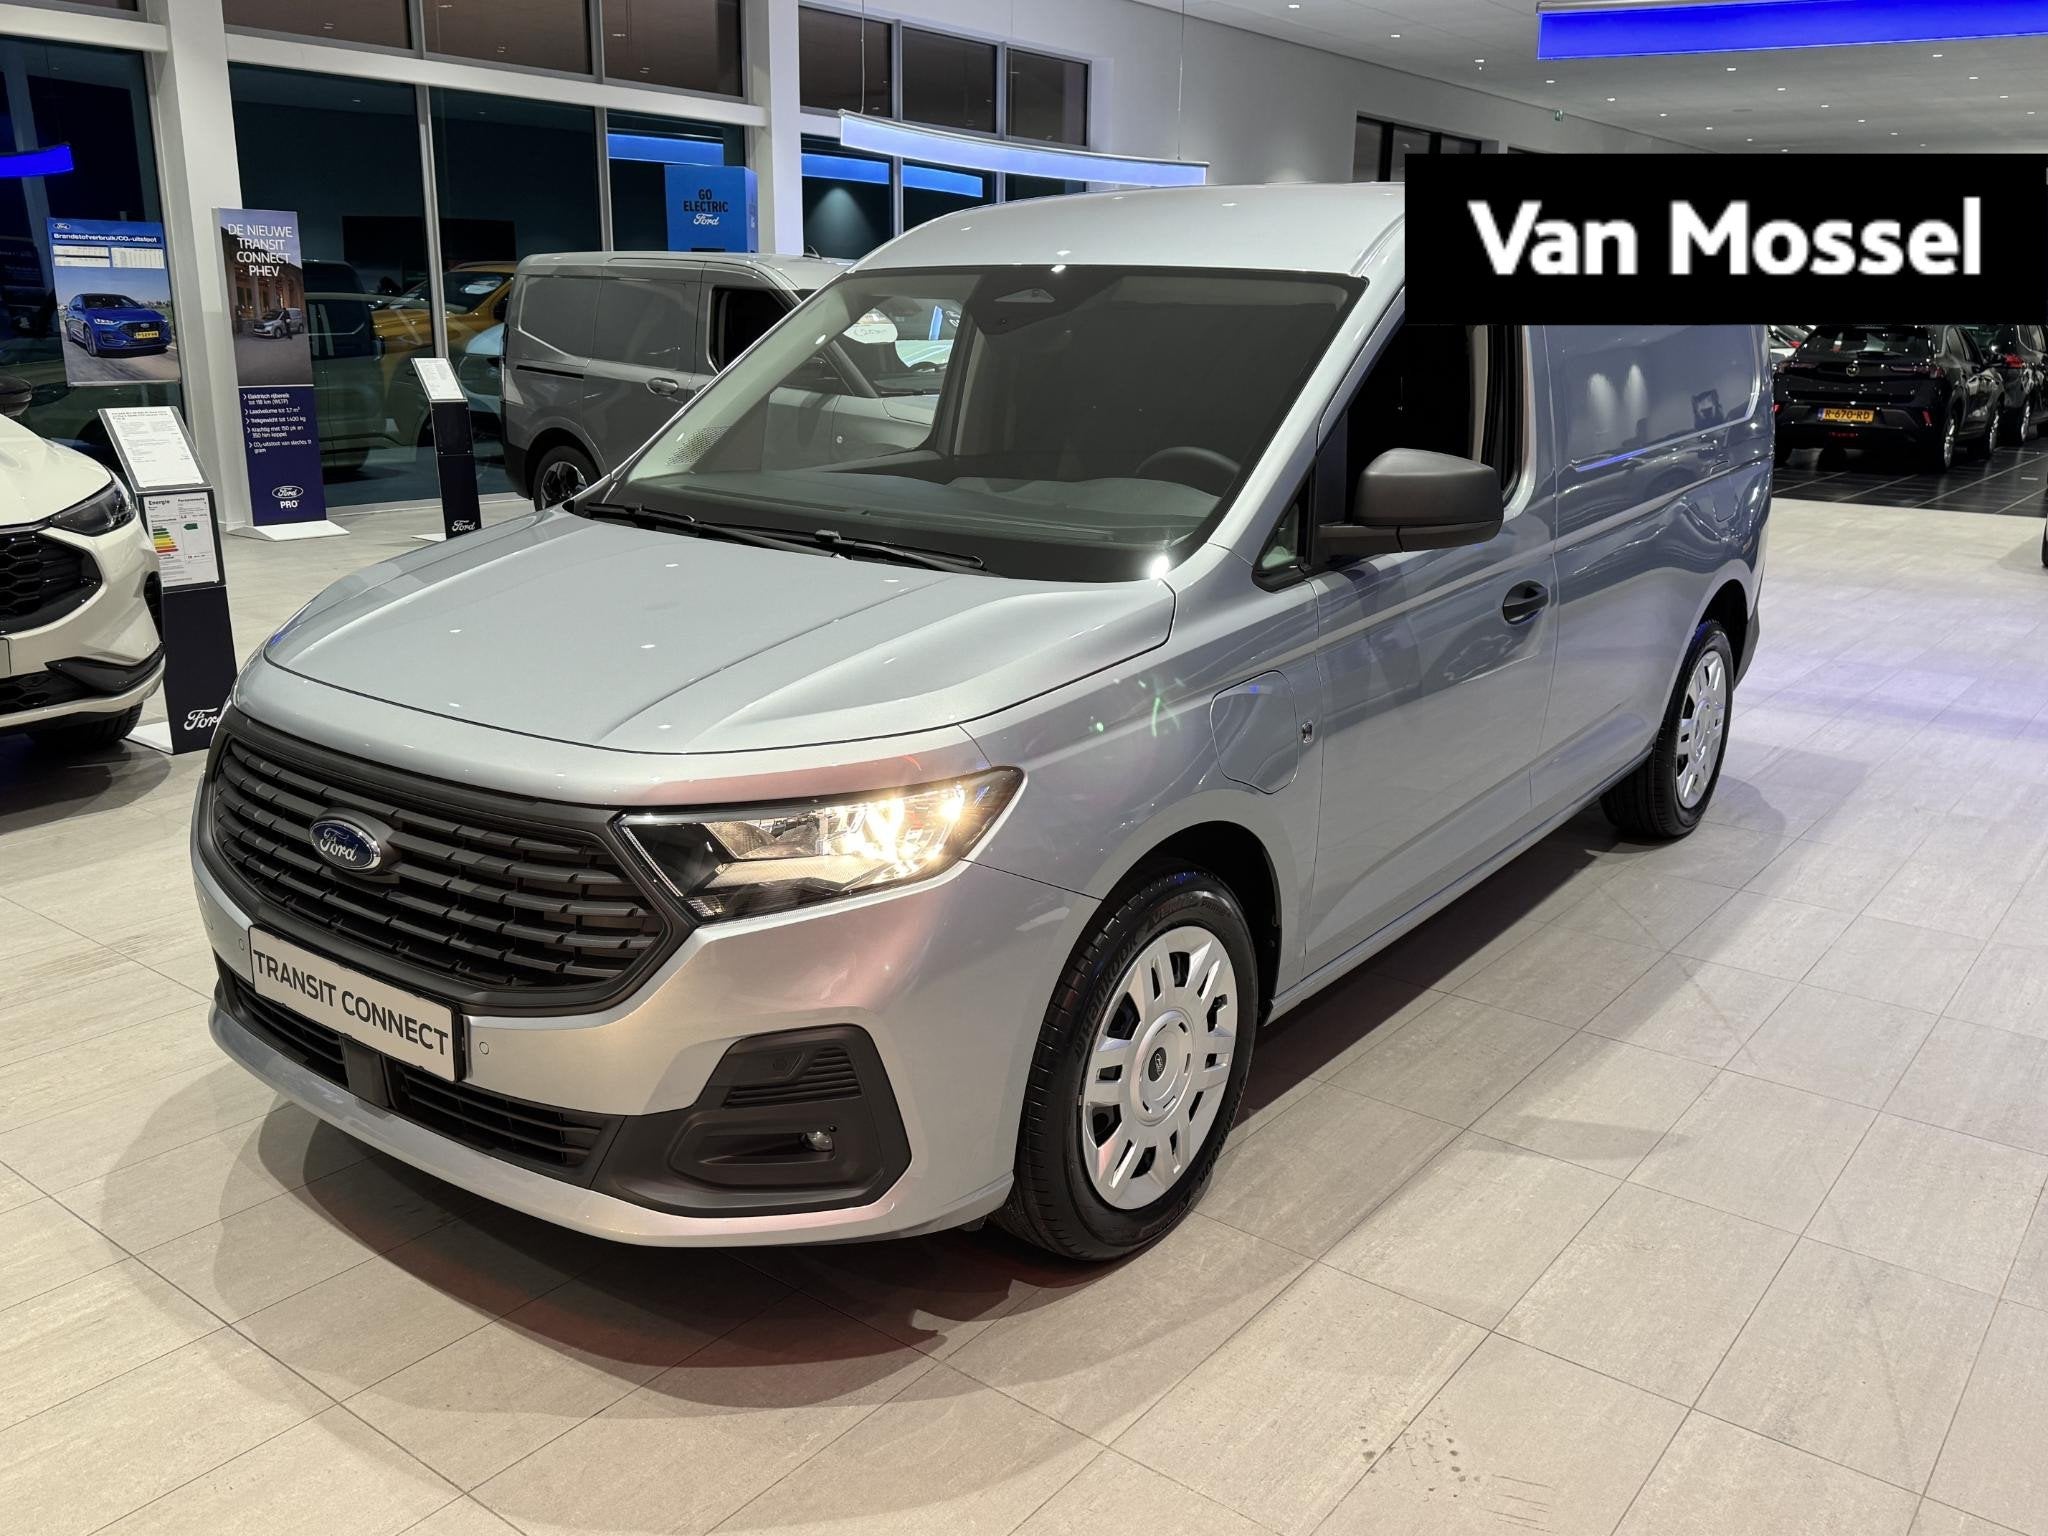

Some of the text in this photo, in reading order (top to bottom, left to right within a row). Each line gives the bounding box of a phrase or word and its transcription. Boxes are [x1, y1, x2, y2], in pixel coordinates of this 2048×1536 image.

[698, 188, 712, 200] GO
[683, 200, 728, 212] ELECTRIC
[693, 213, 719, 225] Ford
[228, 224, 293, 238] DE NIEUWE
[237, 237, 285, 250] TRANSIT
[236, 251, 291, 264] CONNECT
[248, 265, 280, 277] PHEV
[1824, 409, 1870, 420] R-670-RD
[280, 500, 298, 508] PRO
[452, 520, 475, 531] Ford
[184, 707, 220, 731] For
[318, 827, 357, 862] Ford
[253, 949, 448, 1055] TRANSIT CONNECT
